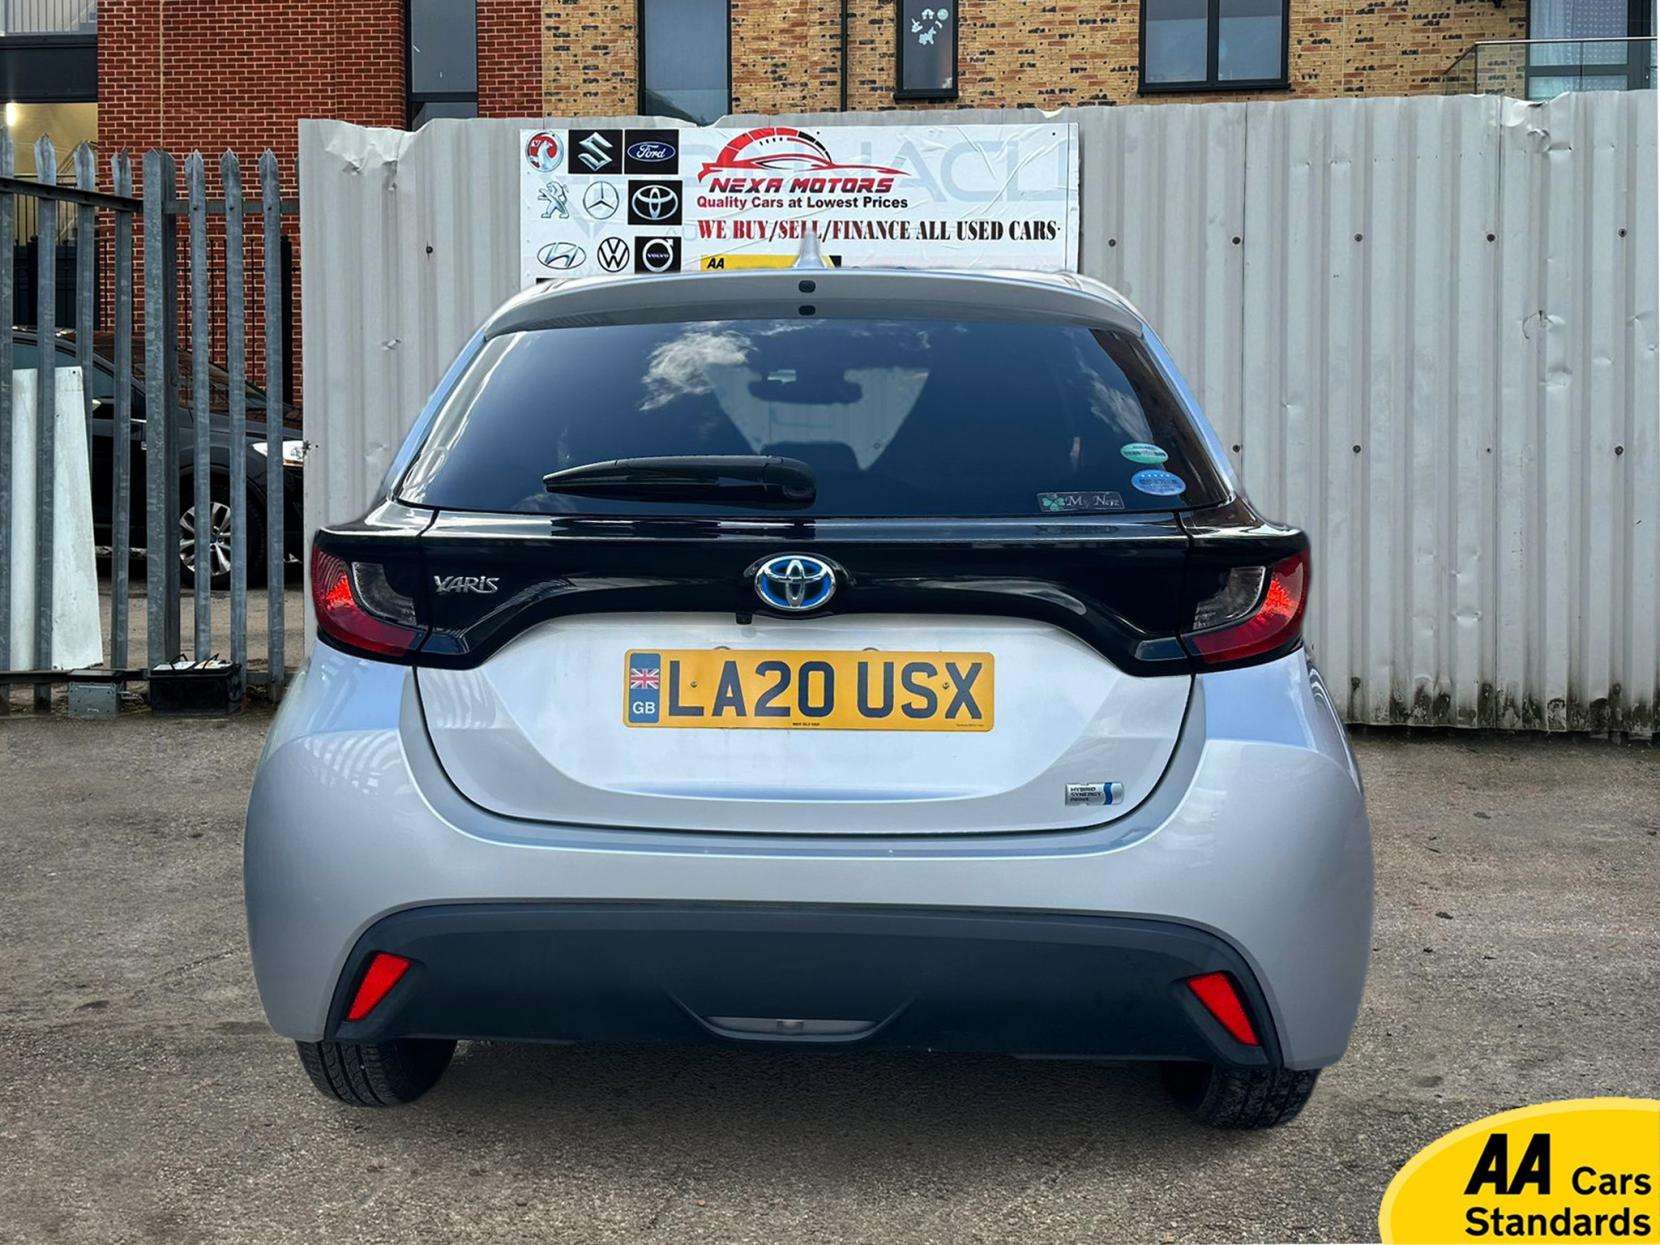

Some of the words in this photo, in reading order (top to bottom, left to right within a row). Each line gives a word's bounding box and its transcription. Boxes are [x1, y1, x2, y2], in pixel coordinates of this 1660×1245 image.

[635, 143, 667, 159] Ford
[709, 177, 784, 193] NEXA
[789, 177, 895, 193] MOTORS
[697, 195, 748, 210] Quality
[751, 196, 784, 208] Cars
[788, 197, 802, 208] at
[806, 196, 859, 208] Lowest
[862, 196, 908, 208] Prices
[697, 219, 727, 240] WE
[916, 219, 951, 240] ALL
[956, 220, 1004, 241] USED
[1008, 220, 1057, 241] CARS
[706, 257, 725, 269] AA
[433, 575, 500, 593] YARIS
[668, 660, 836, 718] LA20
[856, 661, 984, 720] USX
[632, 701, 656, 715] GB
